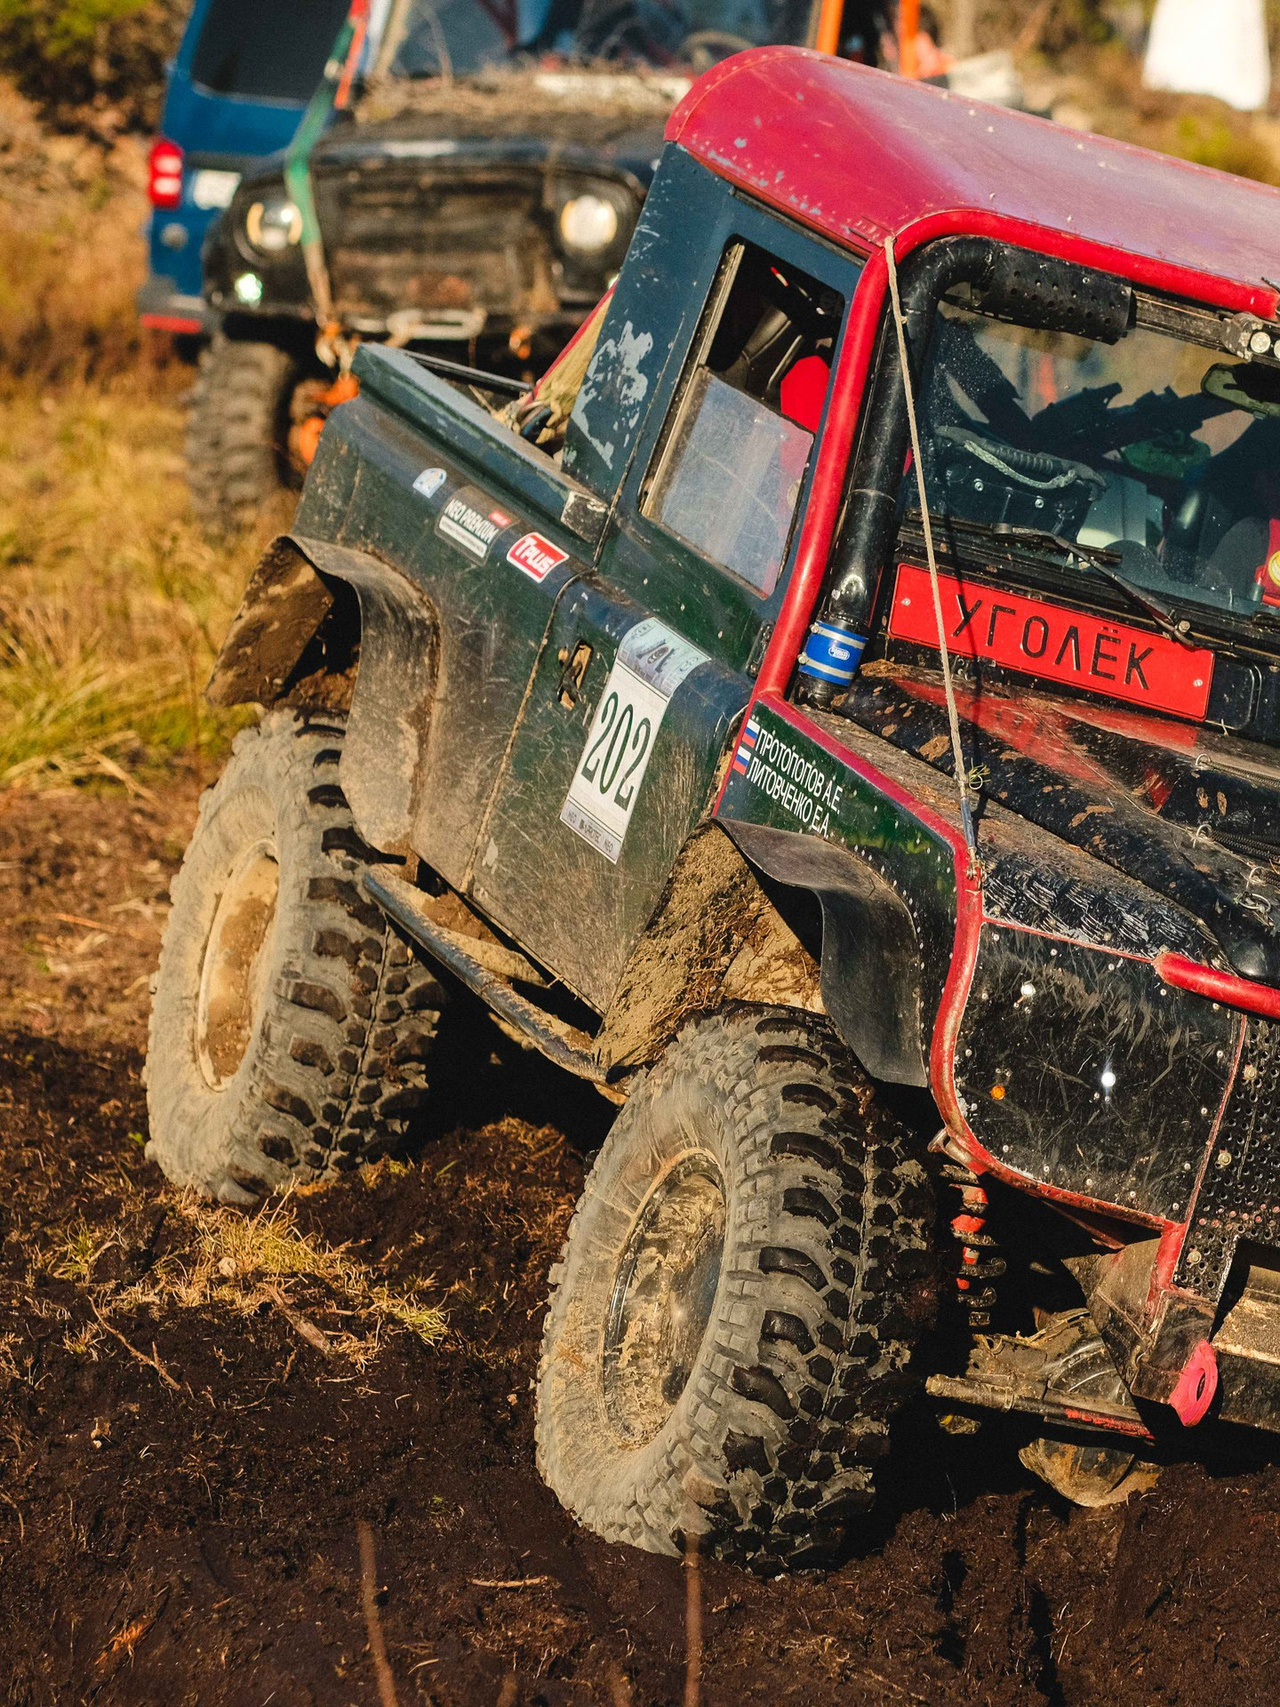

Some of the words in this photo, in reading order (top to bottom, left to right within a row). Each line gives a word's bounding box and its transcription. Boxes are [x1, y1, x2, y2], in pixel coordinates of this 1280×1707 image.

[951, 594, 1154, 691] УГОЛЁК
[580, 691, 652, 813] 202
[746, 756, 813, 823] ЛИТОВЧЕНКО
[755, 728, 825, 798] ПРОТОПОПОВ
